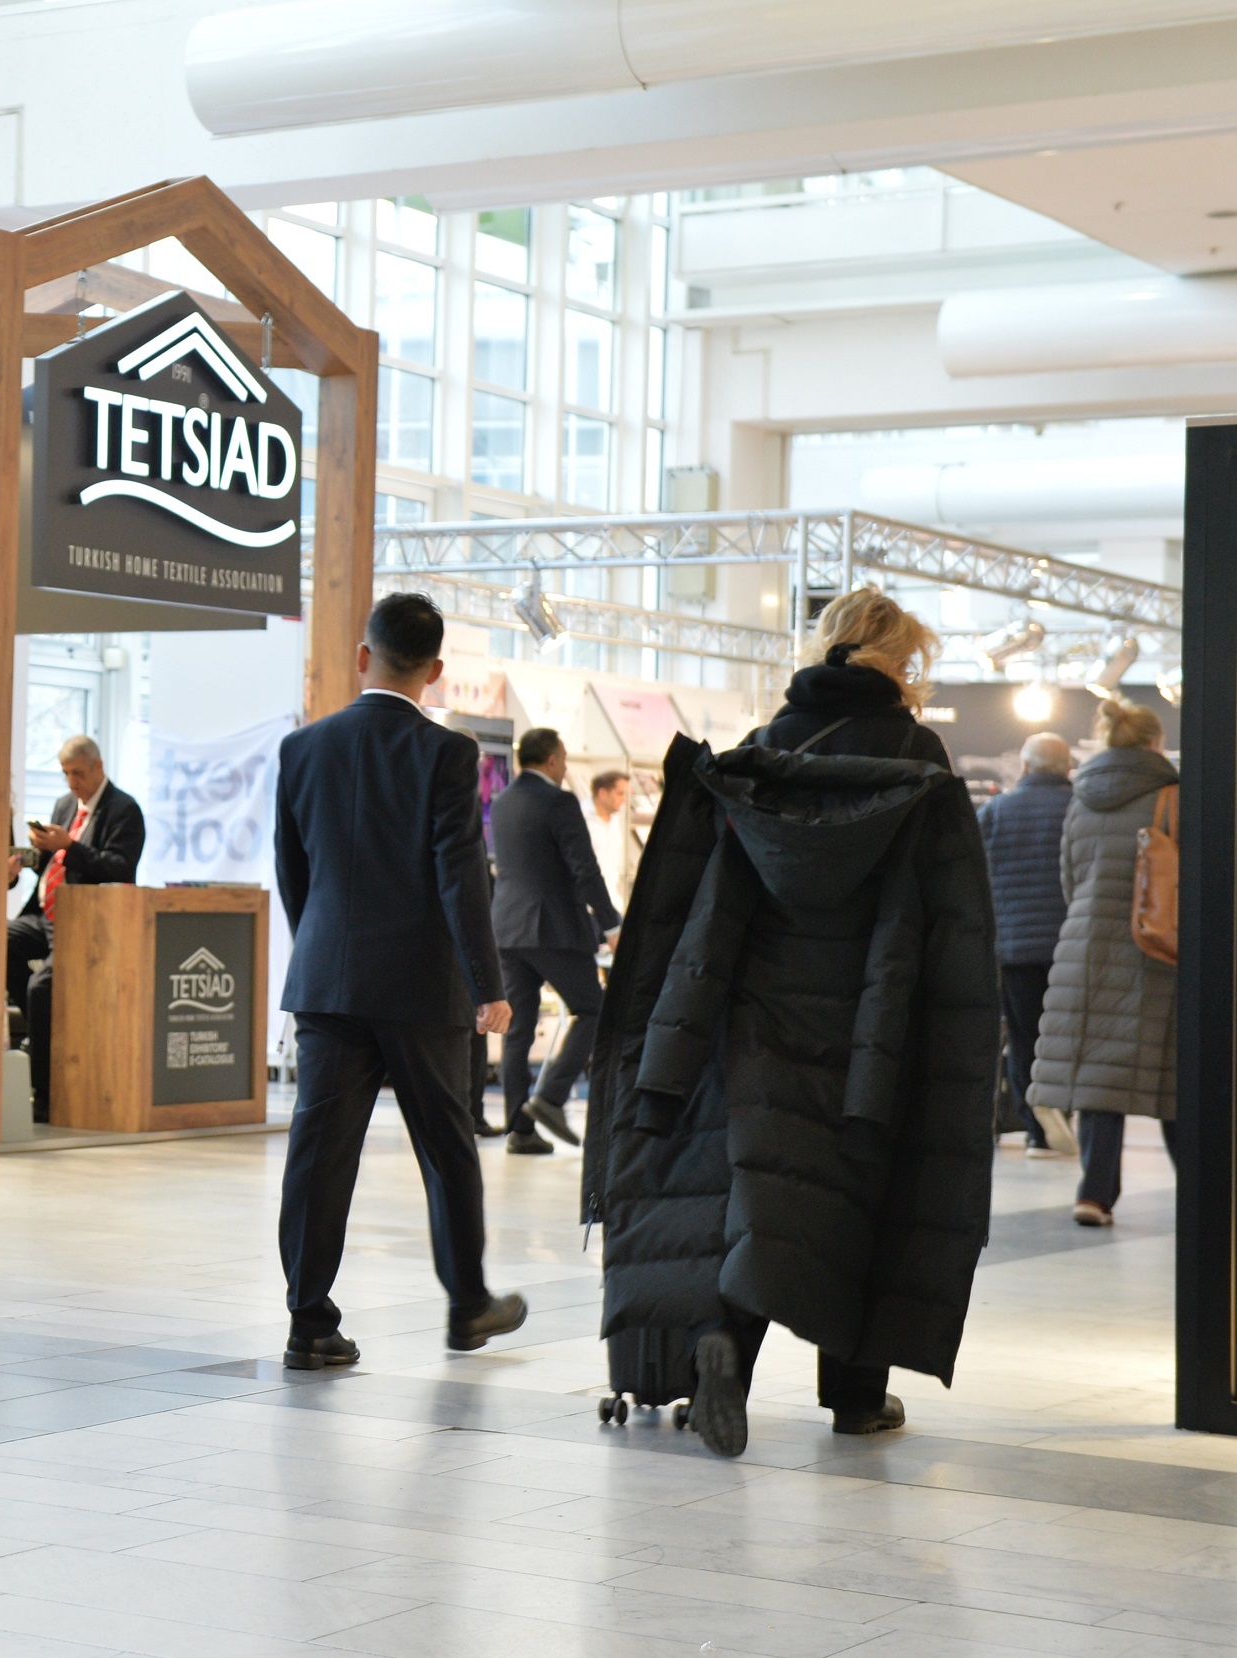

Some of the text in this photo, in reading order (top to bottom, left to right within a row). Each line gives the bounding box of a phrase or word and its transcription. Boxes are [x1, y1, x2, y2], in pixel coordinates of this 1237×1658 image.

[68, 545, 284, 594] TURKISH HOME TEXTILE ASSOCIATION
